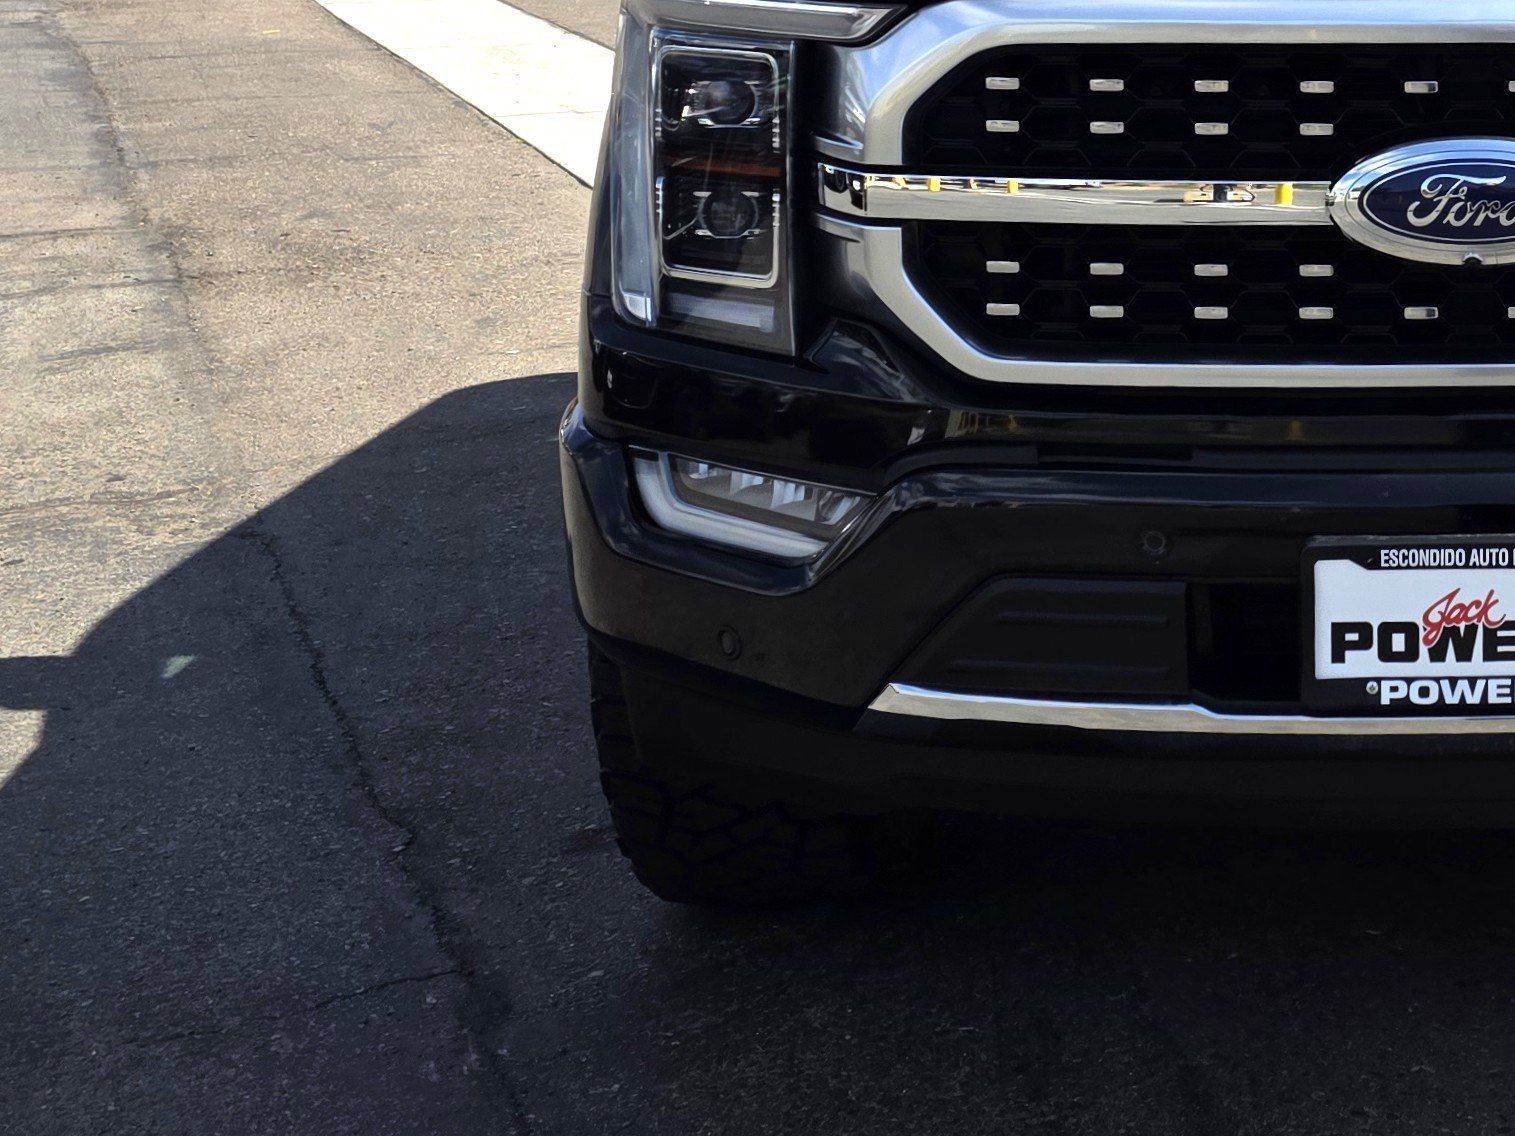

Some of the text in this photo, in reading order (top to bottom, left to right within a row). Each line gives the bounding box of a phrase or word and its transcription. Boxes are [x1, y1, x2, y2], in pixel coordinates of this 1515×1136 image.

[1380, 549, 1466, 567] ESCONDIDO
[1469, 548, 1508, 567] AUTO
[1422, 587, 1507, 648] Jack
